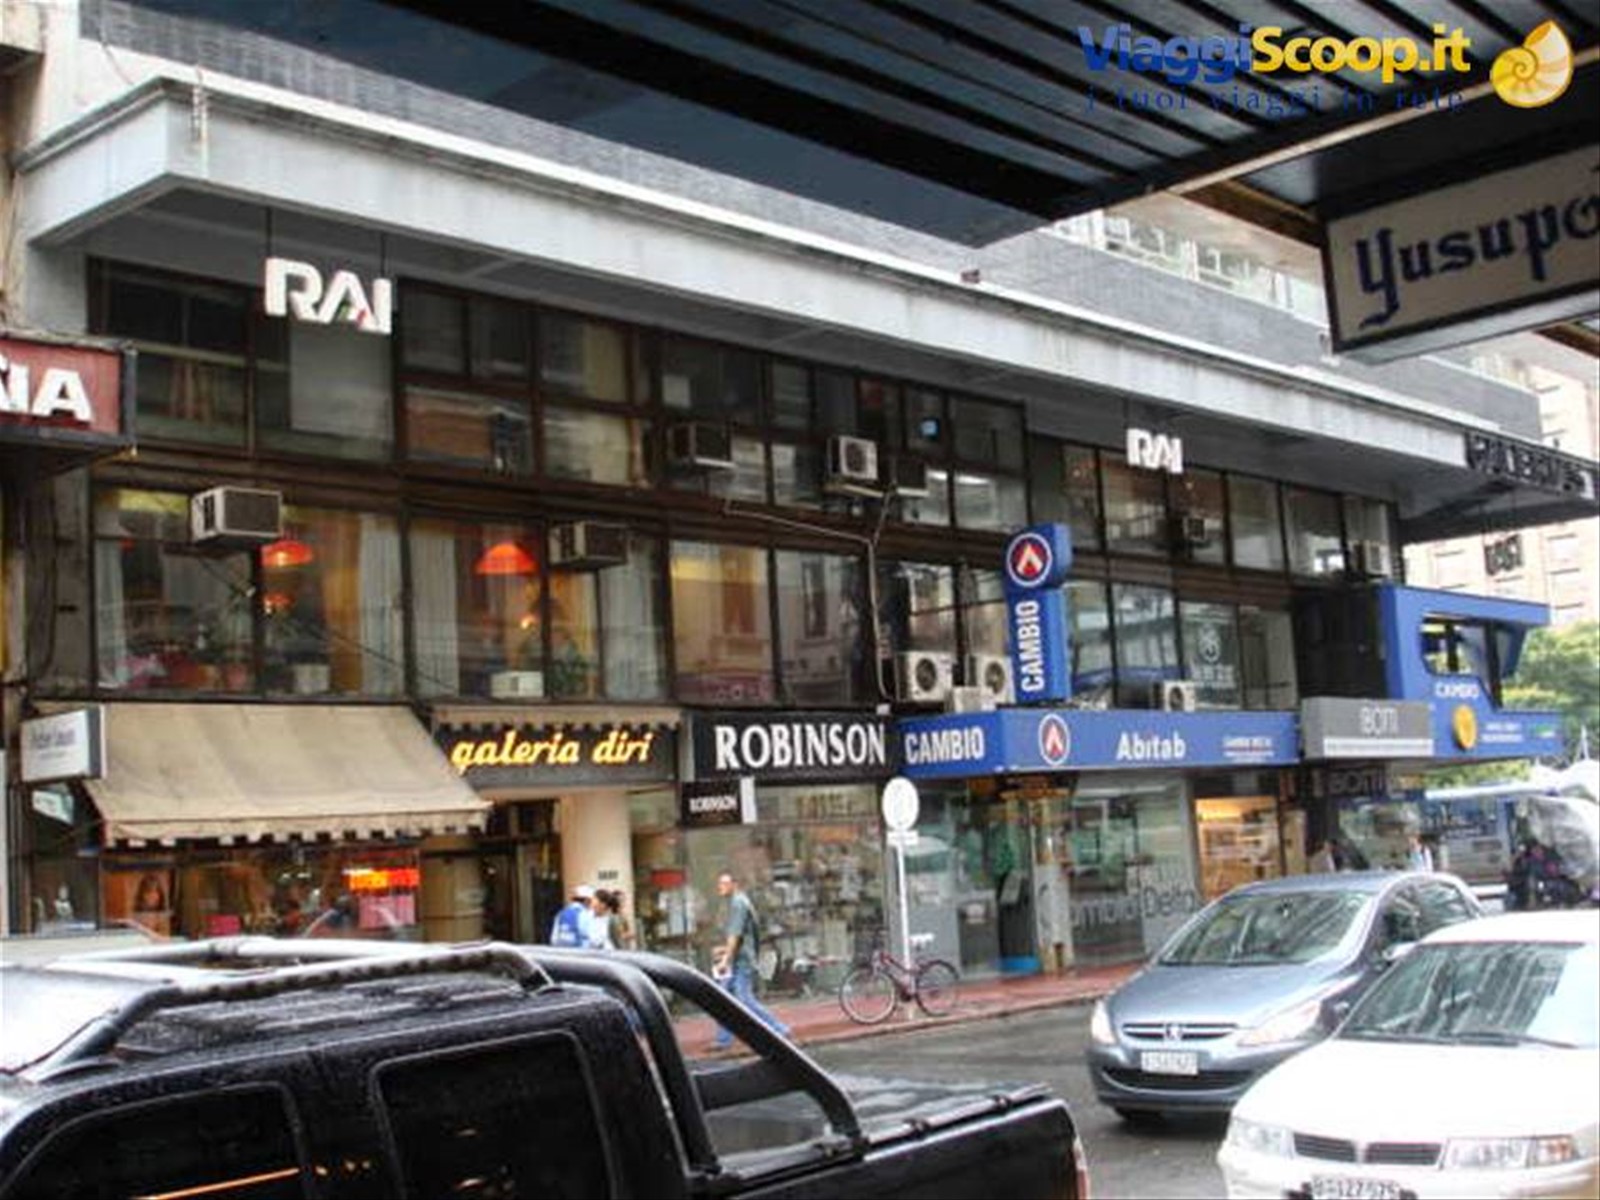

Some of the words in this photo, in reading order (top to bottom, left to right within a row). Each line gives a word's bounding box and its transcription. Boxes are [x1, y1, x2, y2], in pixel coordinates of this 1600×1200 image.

[1355, 193, 1600, 330] Yusupo
[264, 257, 392, 335] RAI
[1126, 428, 1183, 474] RAI
[1014, 600, 1045, 692] CAMBIO
[452, 730, 580, 776] galeria
[592, 731, 654, 763] diri
[714, 723, 887, 770] ROBINSON
[904, 726, 986, 765] CAMBIO
[1116, 731, 1187, 761] Abitab
